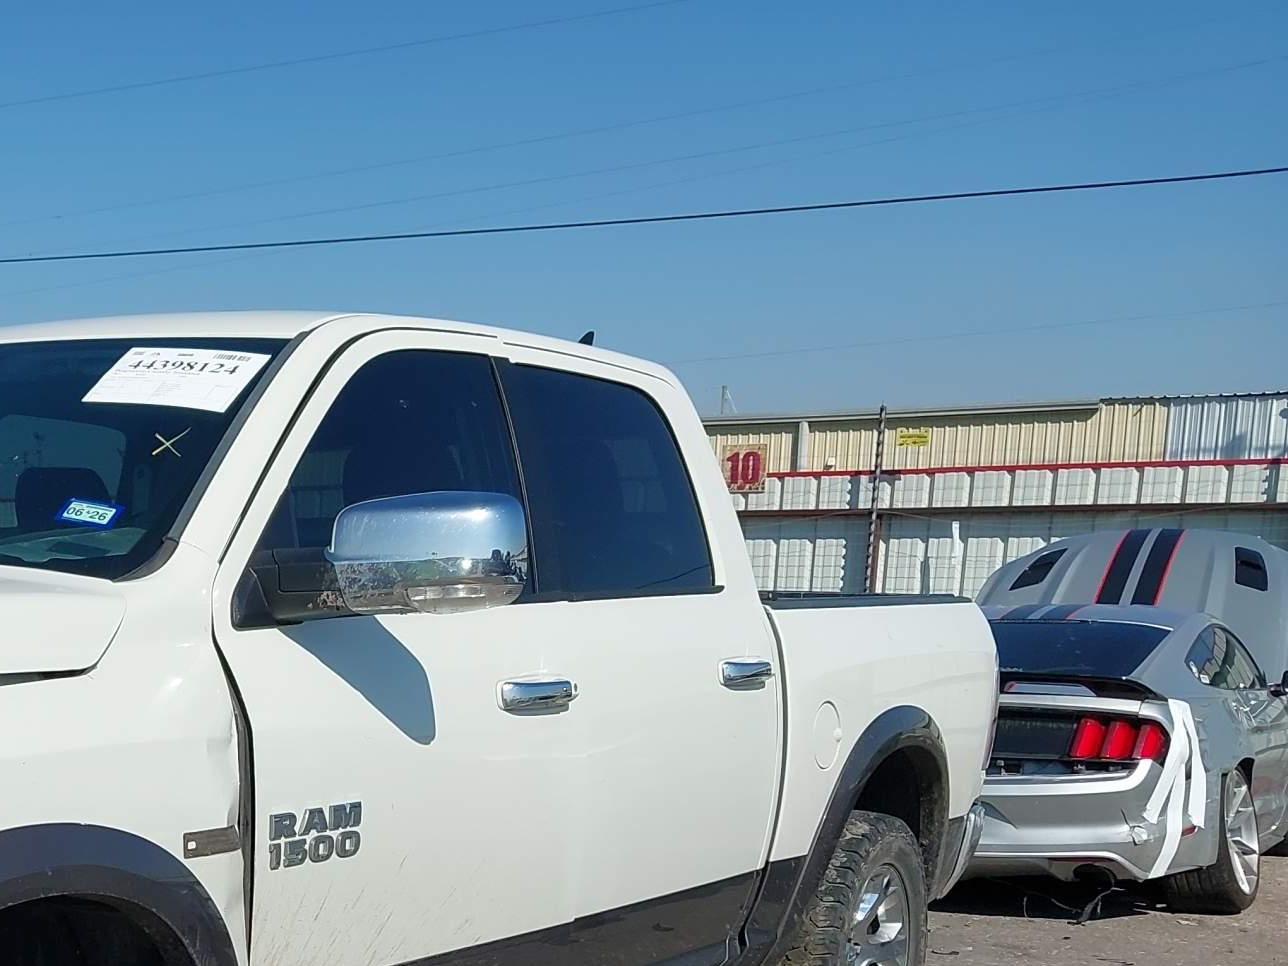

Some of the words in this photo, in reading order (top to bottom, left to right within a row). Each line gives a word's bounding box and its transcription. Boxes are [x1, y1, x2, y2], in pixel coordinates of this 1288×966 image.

[129, 359, 240, 375] 44398124
[726, 451, 761, 484] 10
[66, 507, 84, 517] 06
[89, 511, 109, 521] 26
[268, 801, 362, 841] RAM
[268, 830, 361, 871] 1500
